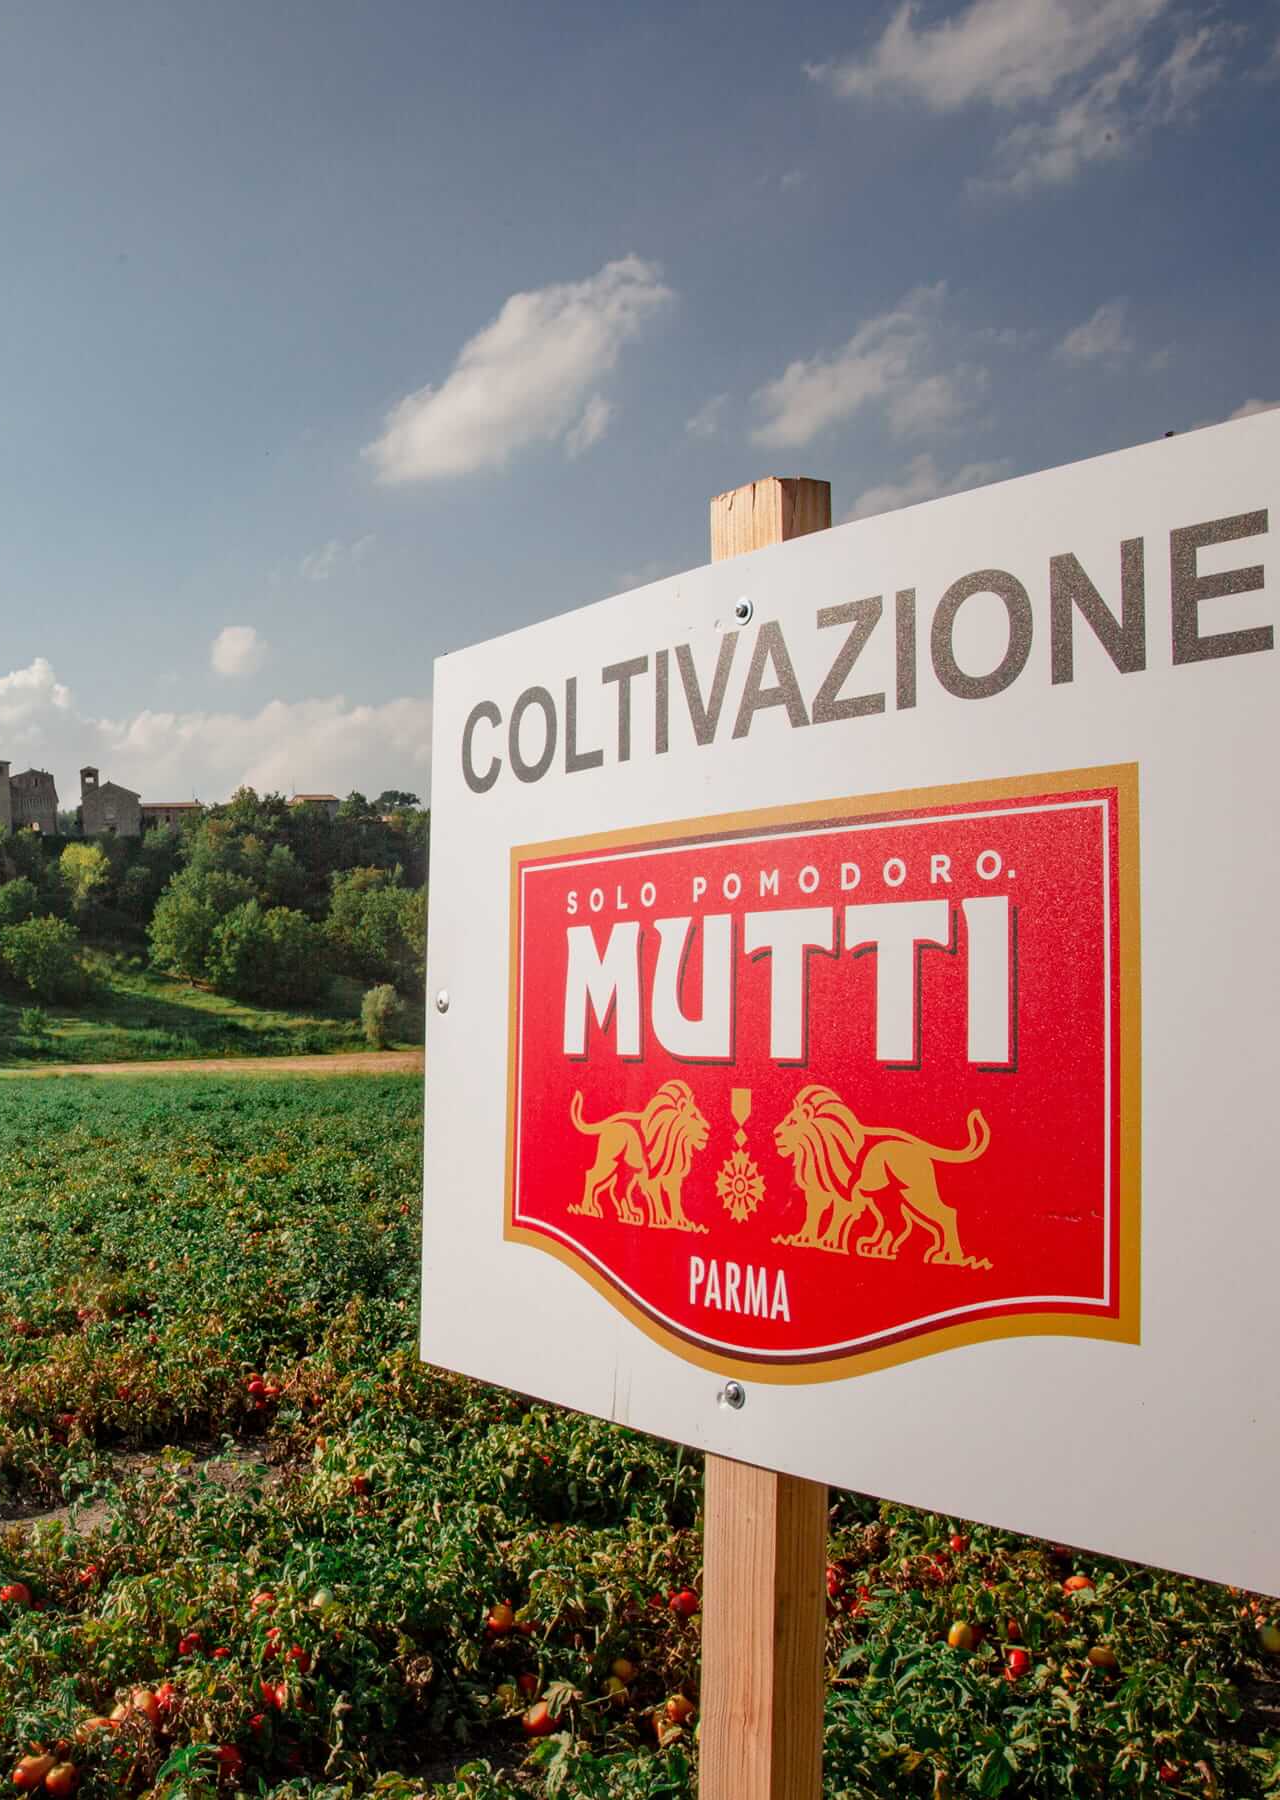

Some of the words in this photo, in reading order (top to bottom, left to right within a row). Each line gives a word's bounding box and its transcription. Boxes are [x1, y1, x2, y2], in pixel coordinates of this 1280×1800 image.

[461, 508, 1274, 795] COLTIVAZIONE
[567, 881, 657, 914] SOLO
[693, 849, 1017, 902] POMODORO.
[563, 895, 1017, 1072] MUTTI
[689, 1255, 791, 1323] PARMA
